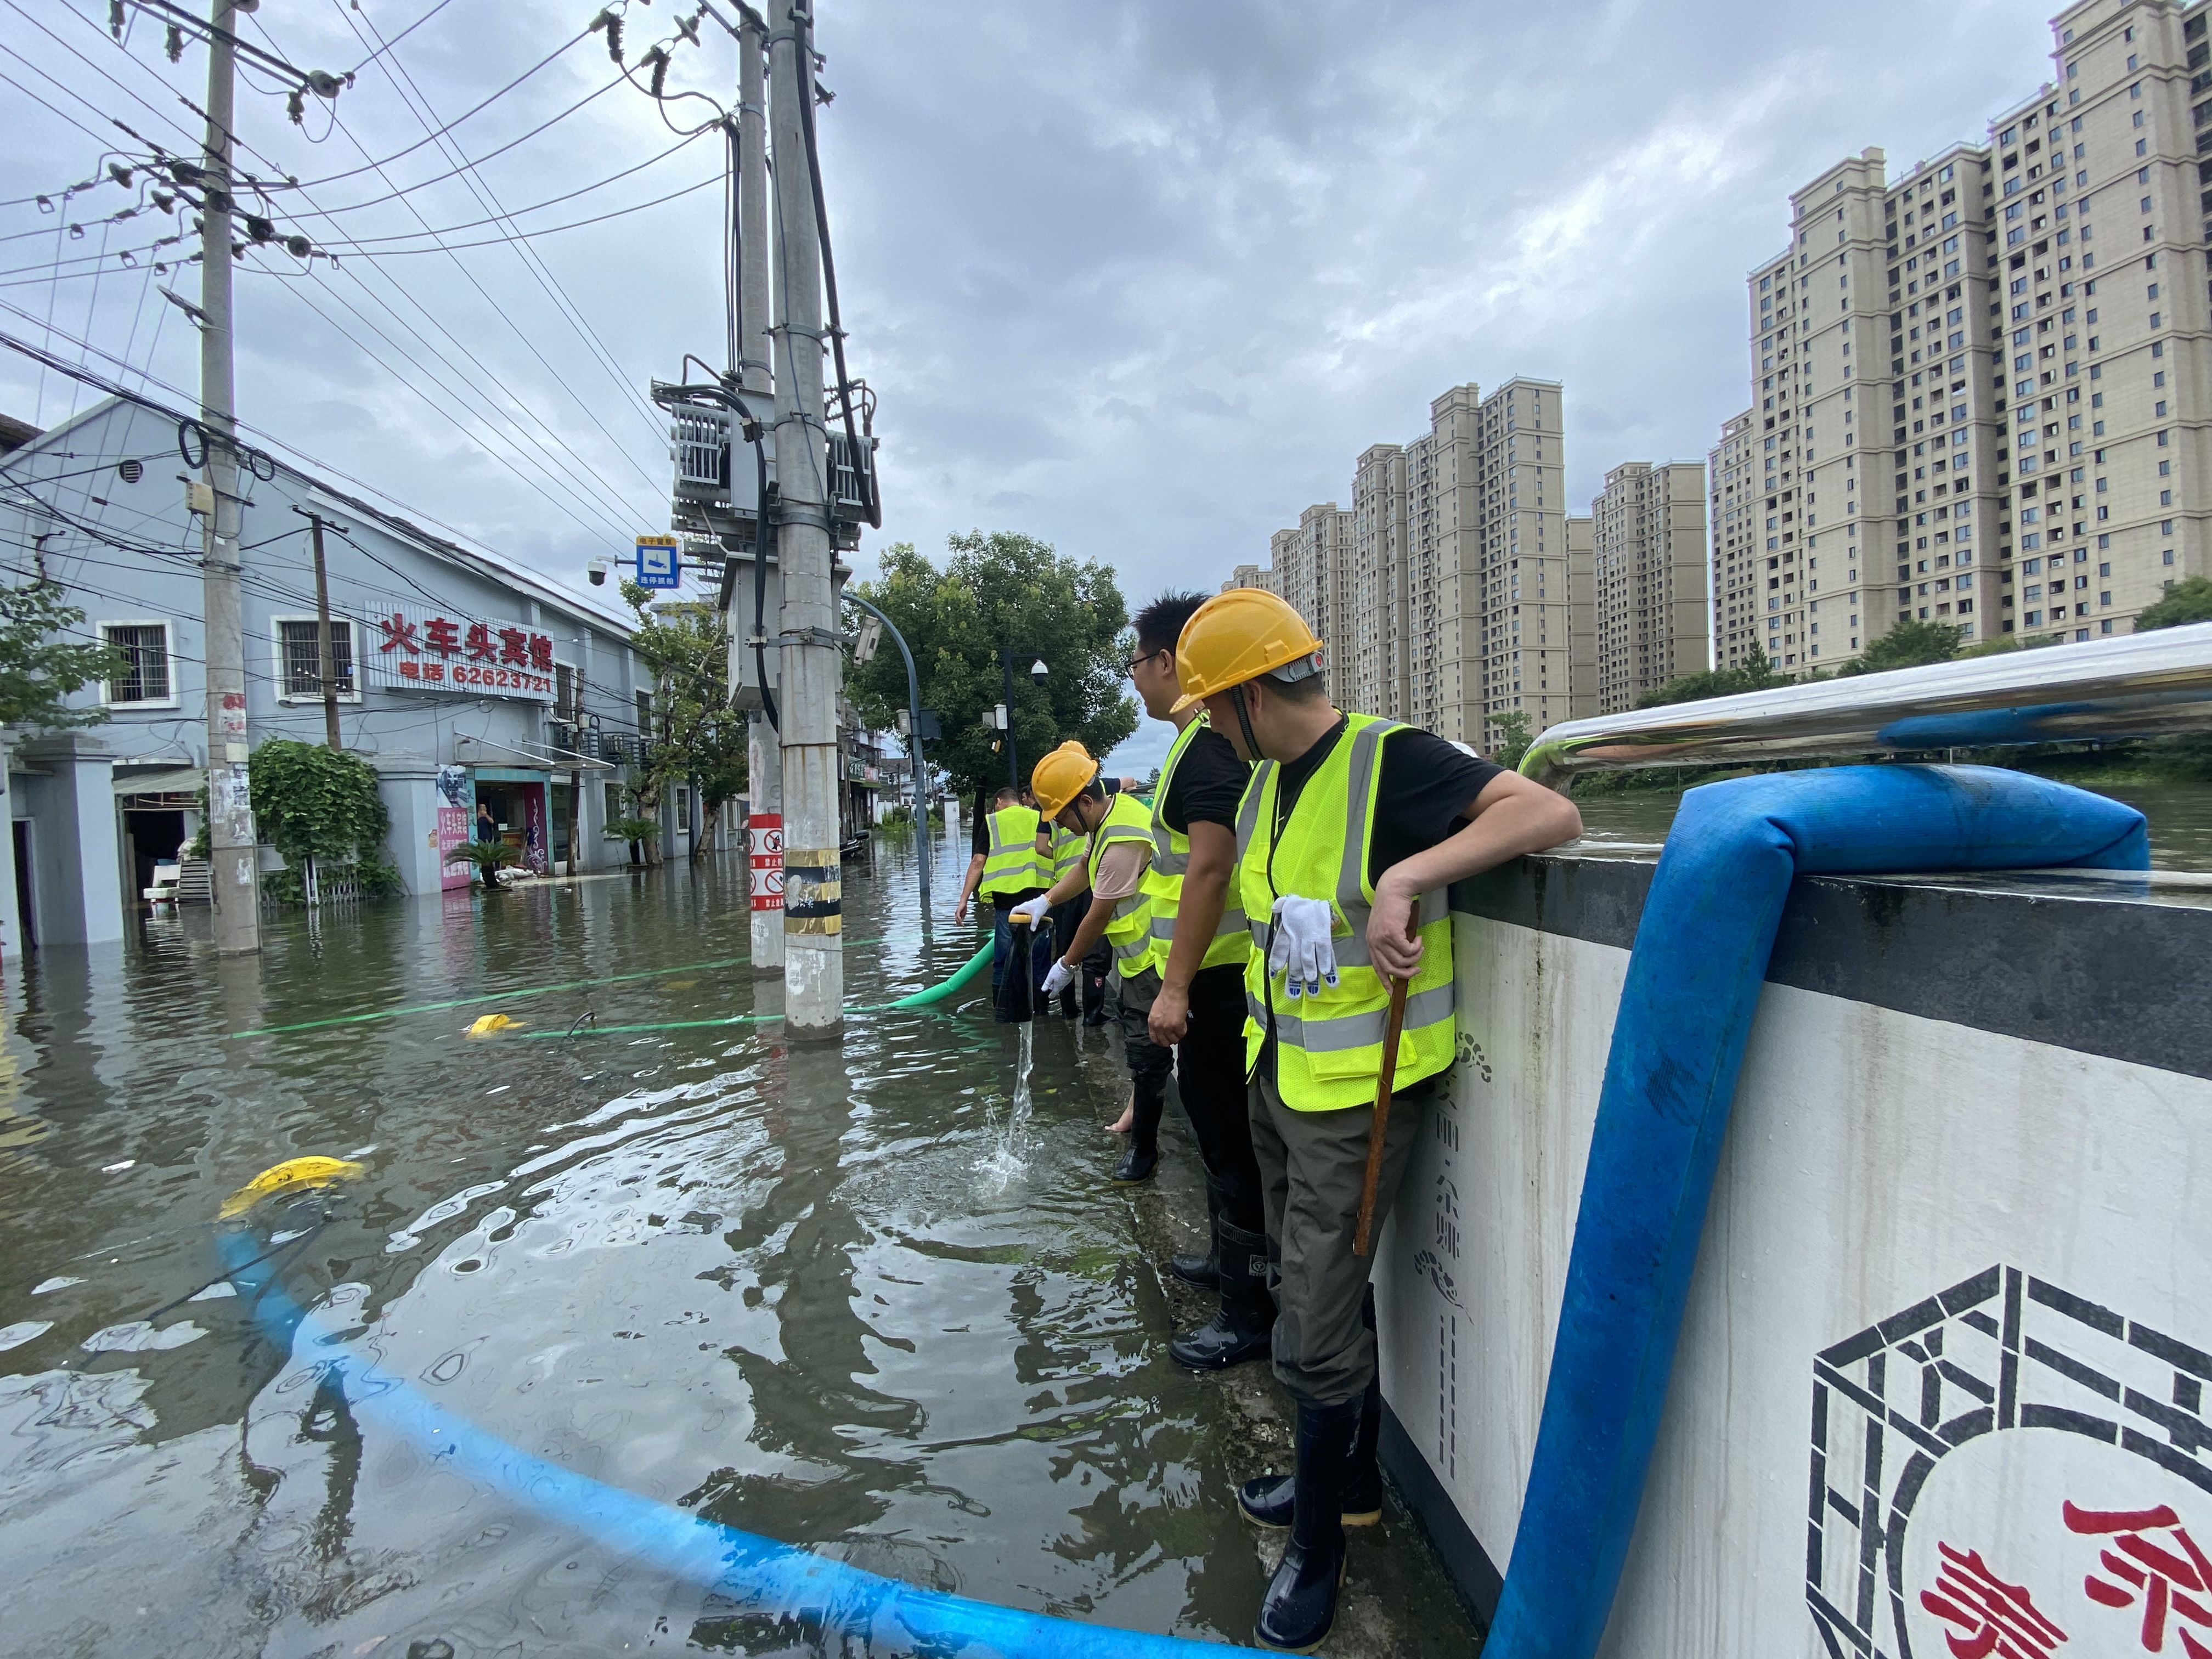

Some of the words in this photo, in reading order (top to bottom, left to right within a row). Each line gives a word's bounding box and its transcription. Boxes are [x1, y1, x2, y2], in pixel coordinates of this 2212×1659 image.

[380, 613, 552, 672] 火车头宾馆
[399, 661, 444, 680] 电话
[453, 666, 551, 692] 62623721
